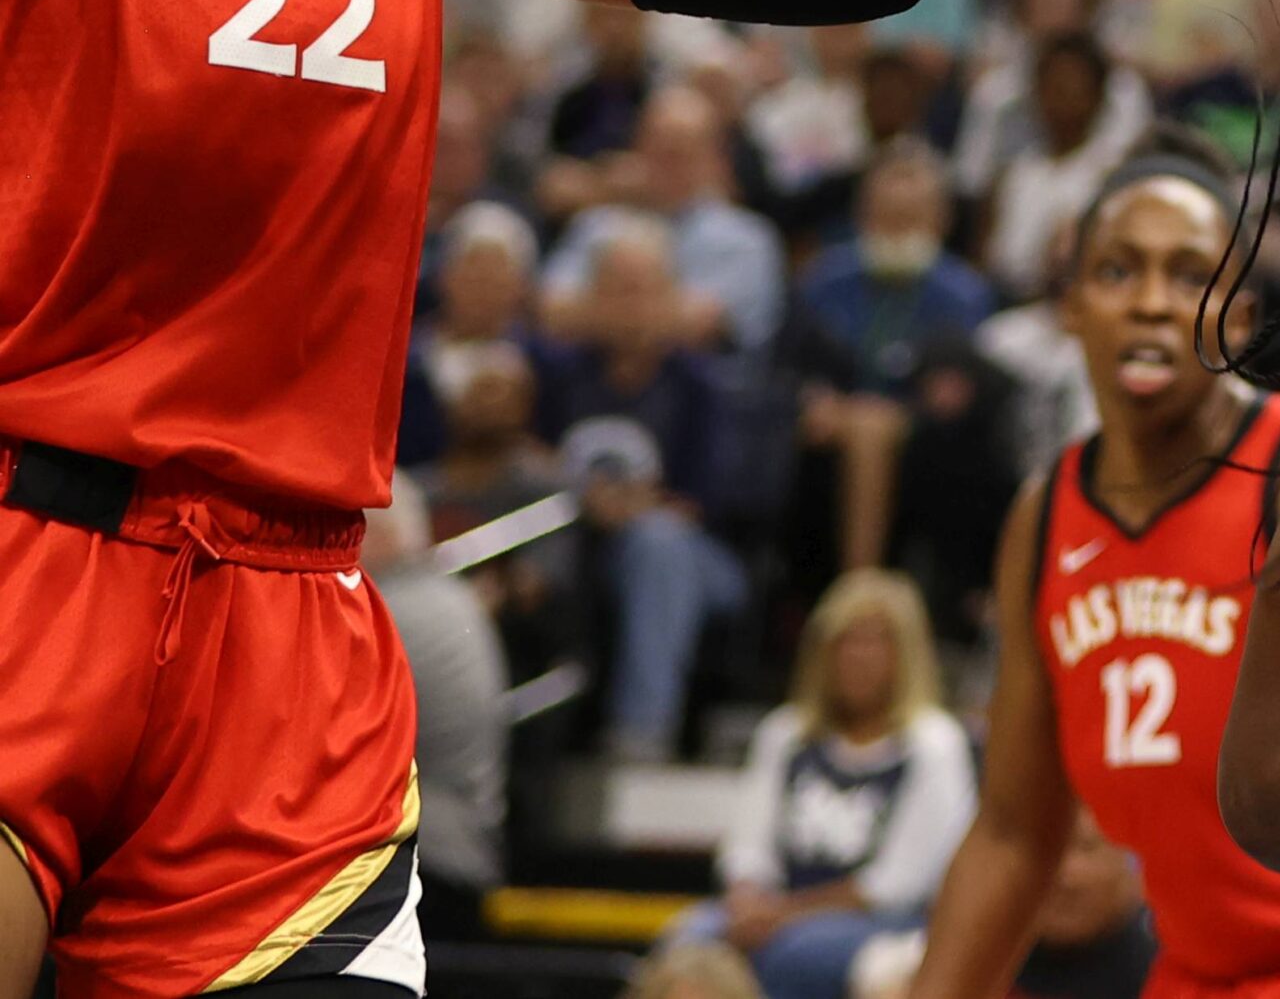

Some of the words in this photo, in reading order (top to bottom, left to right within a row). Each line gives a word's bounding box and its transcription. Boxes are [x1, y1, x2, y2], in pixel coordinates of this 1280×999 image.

[1050, 583, 1118, 669] LAS
[1114, 576, 1241, 657] VEGAS
[1100, 652, 1182, 768] 12
